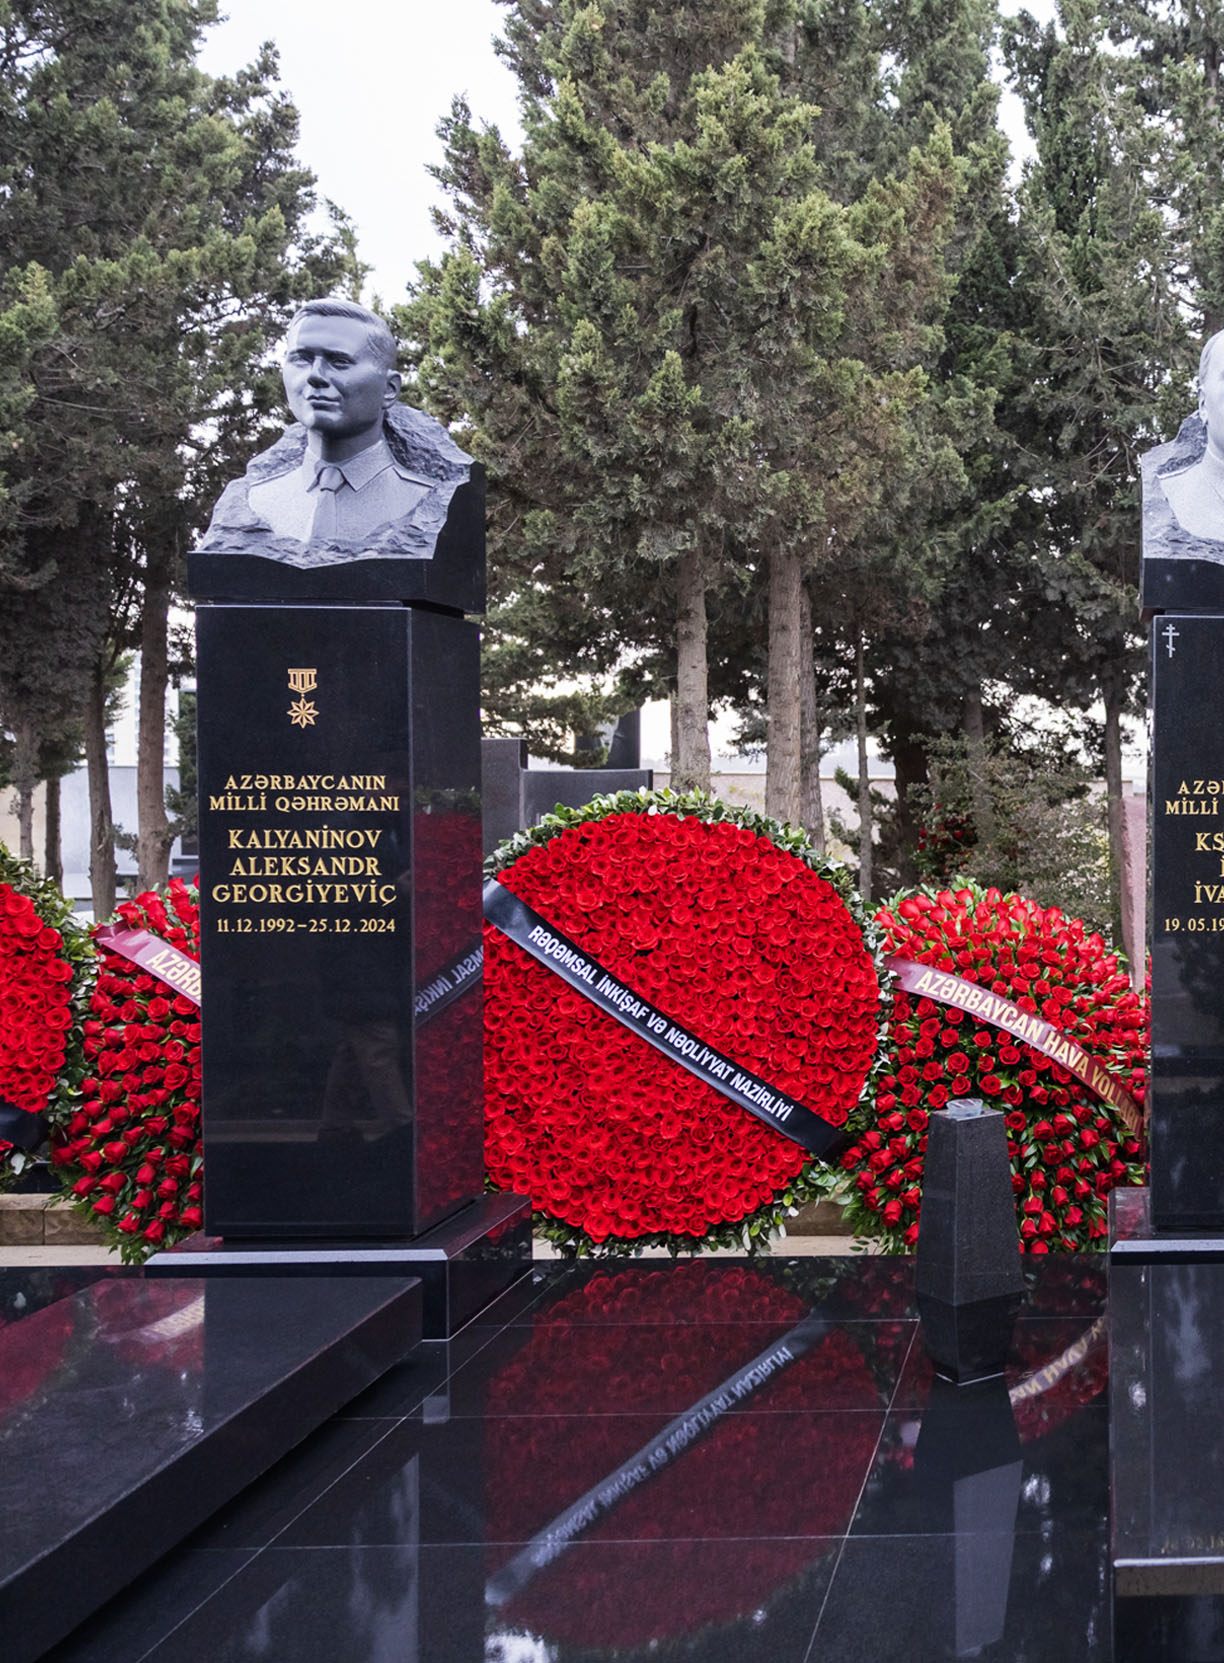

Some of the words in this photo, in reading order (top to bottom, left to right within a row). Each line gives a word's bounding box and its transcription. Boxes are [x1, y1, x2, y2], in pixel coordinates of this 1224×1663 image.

[223, 774, 386, 790] AZƏRBAYCANIN
[209, 791, 267, 811] MİLLİ
[275, 795, 400, 812] QƏHRƏMANI
[1165, 797, 1218, 815] MİLLİ
[228, 824, 383, 849] KALYANİNOV
[229, 856, 383, 876] ALEKSANDR
[211, 879, 397, 906] GEORGİYEVİÇ
[145, 949, 201, 1000] AZƏRB
[527, 925, 595, 985] RƏQƏMSAL
[596, 974, 650, 1019] İNKİŞAF
[646, 1013, 668, 1034] VƏ
[664, 1027, 735, 1080] NƏQLİYYAT
[729, 1072, 795, 1122] NAZİRLİYİ
[914, 970, 1045, 1043] AZƏRBAYCAN
[1044, 1029, 1089, 1078] HAVA
